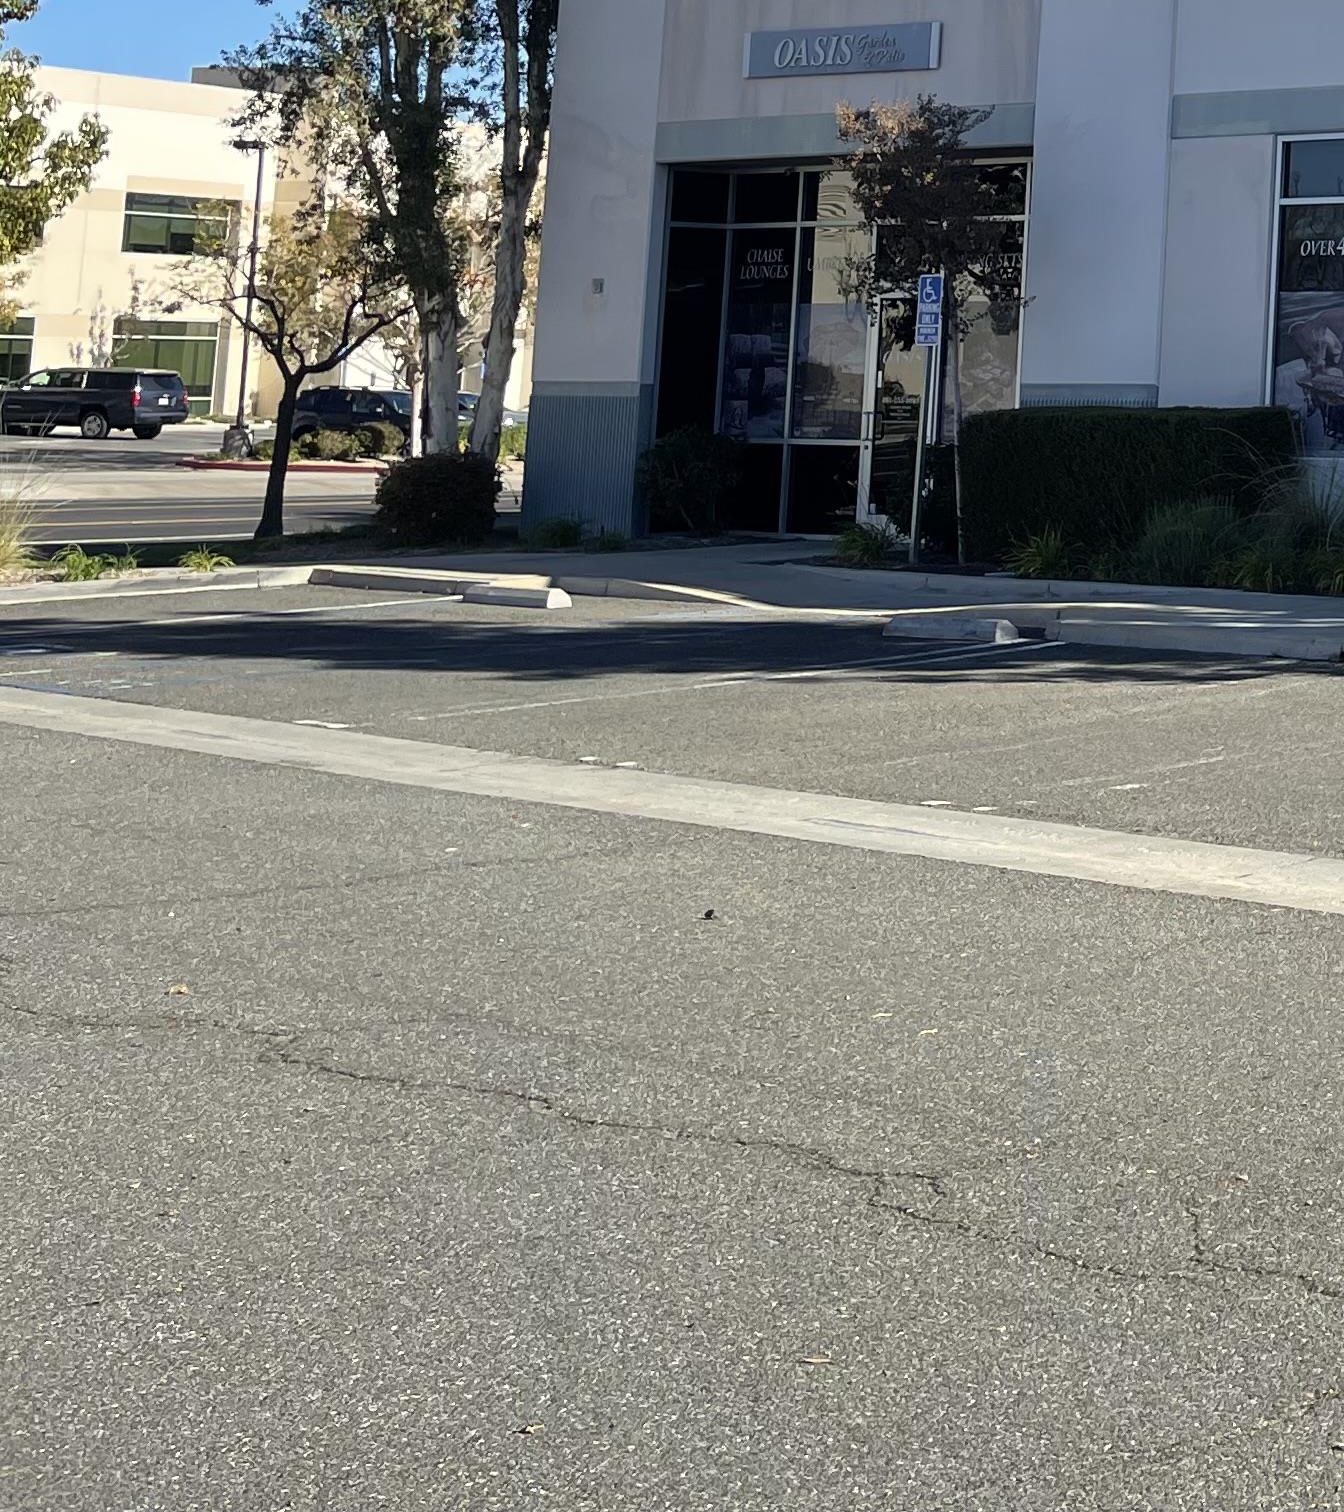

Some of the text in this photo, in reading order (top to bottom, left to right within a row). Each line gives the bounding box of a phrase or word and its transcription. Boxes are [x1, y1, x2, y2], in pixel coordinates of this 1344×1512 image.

[774, 34, 855, 68] OASIS
[747, 248, 784, 263] CHAISE
[740, 265, 789, 280] LOUNGES
